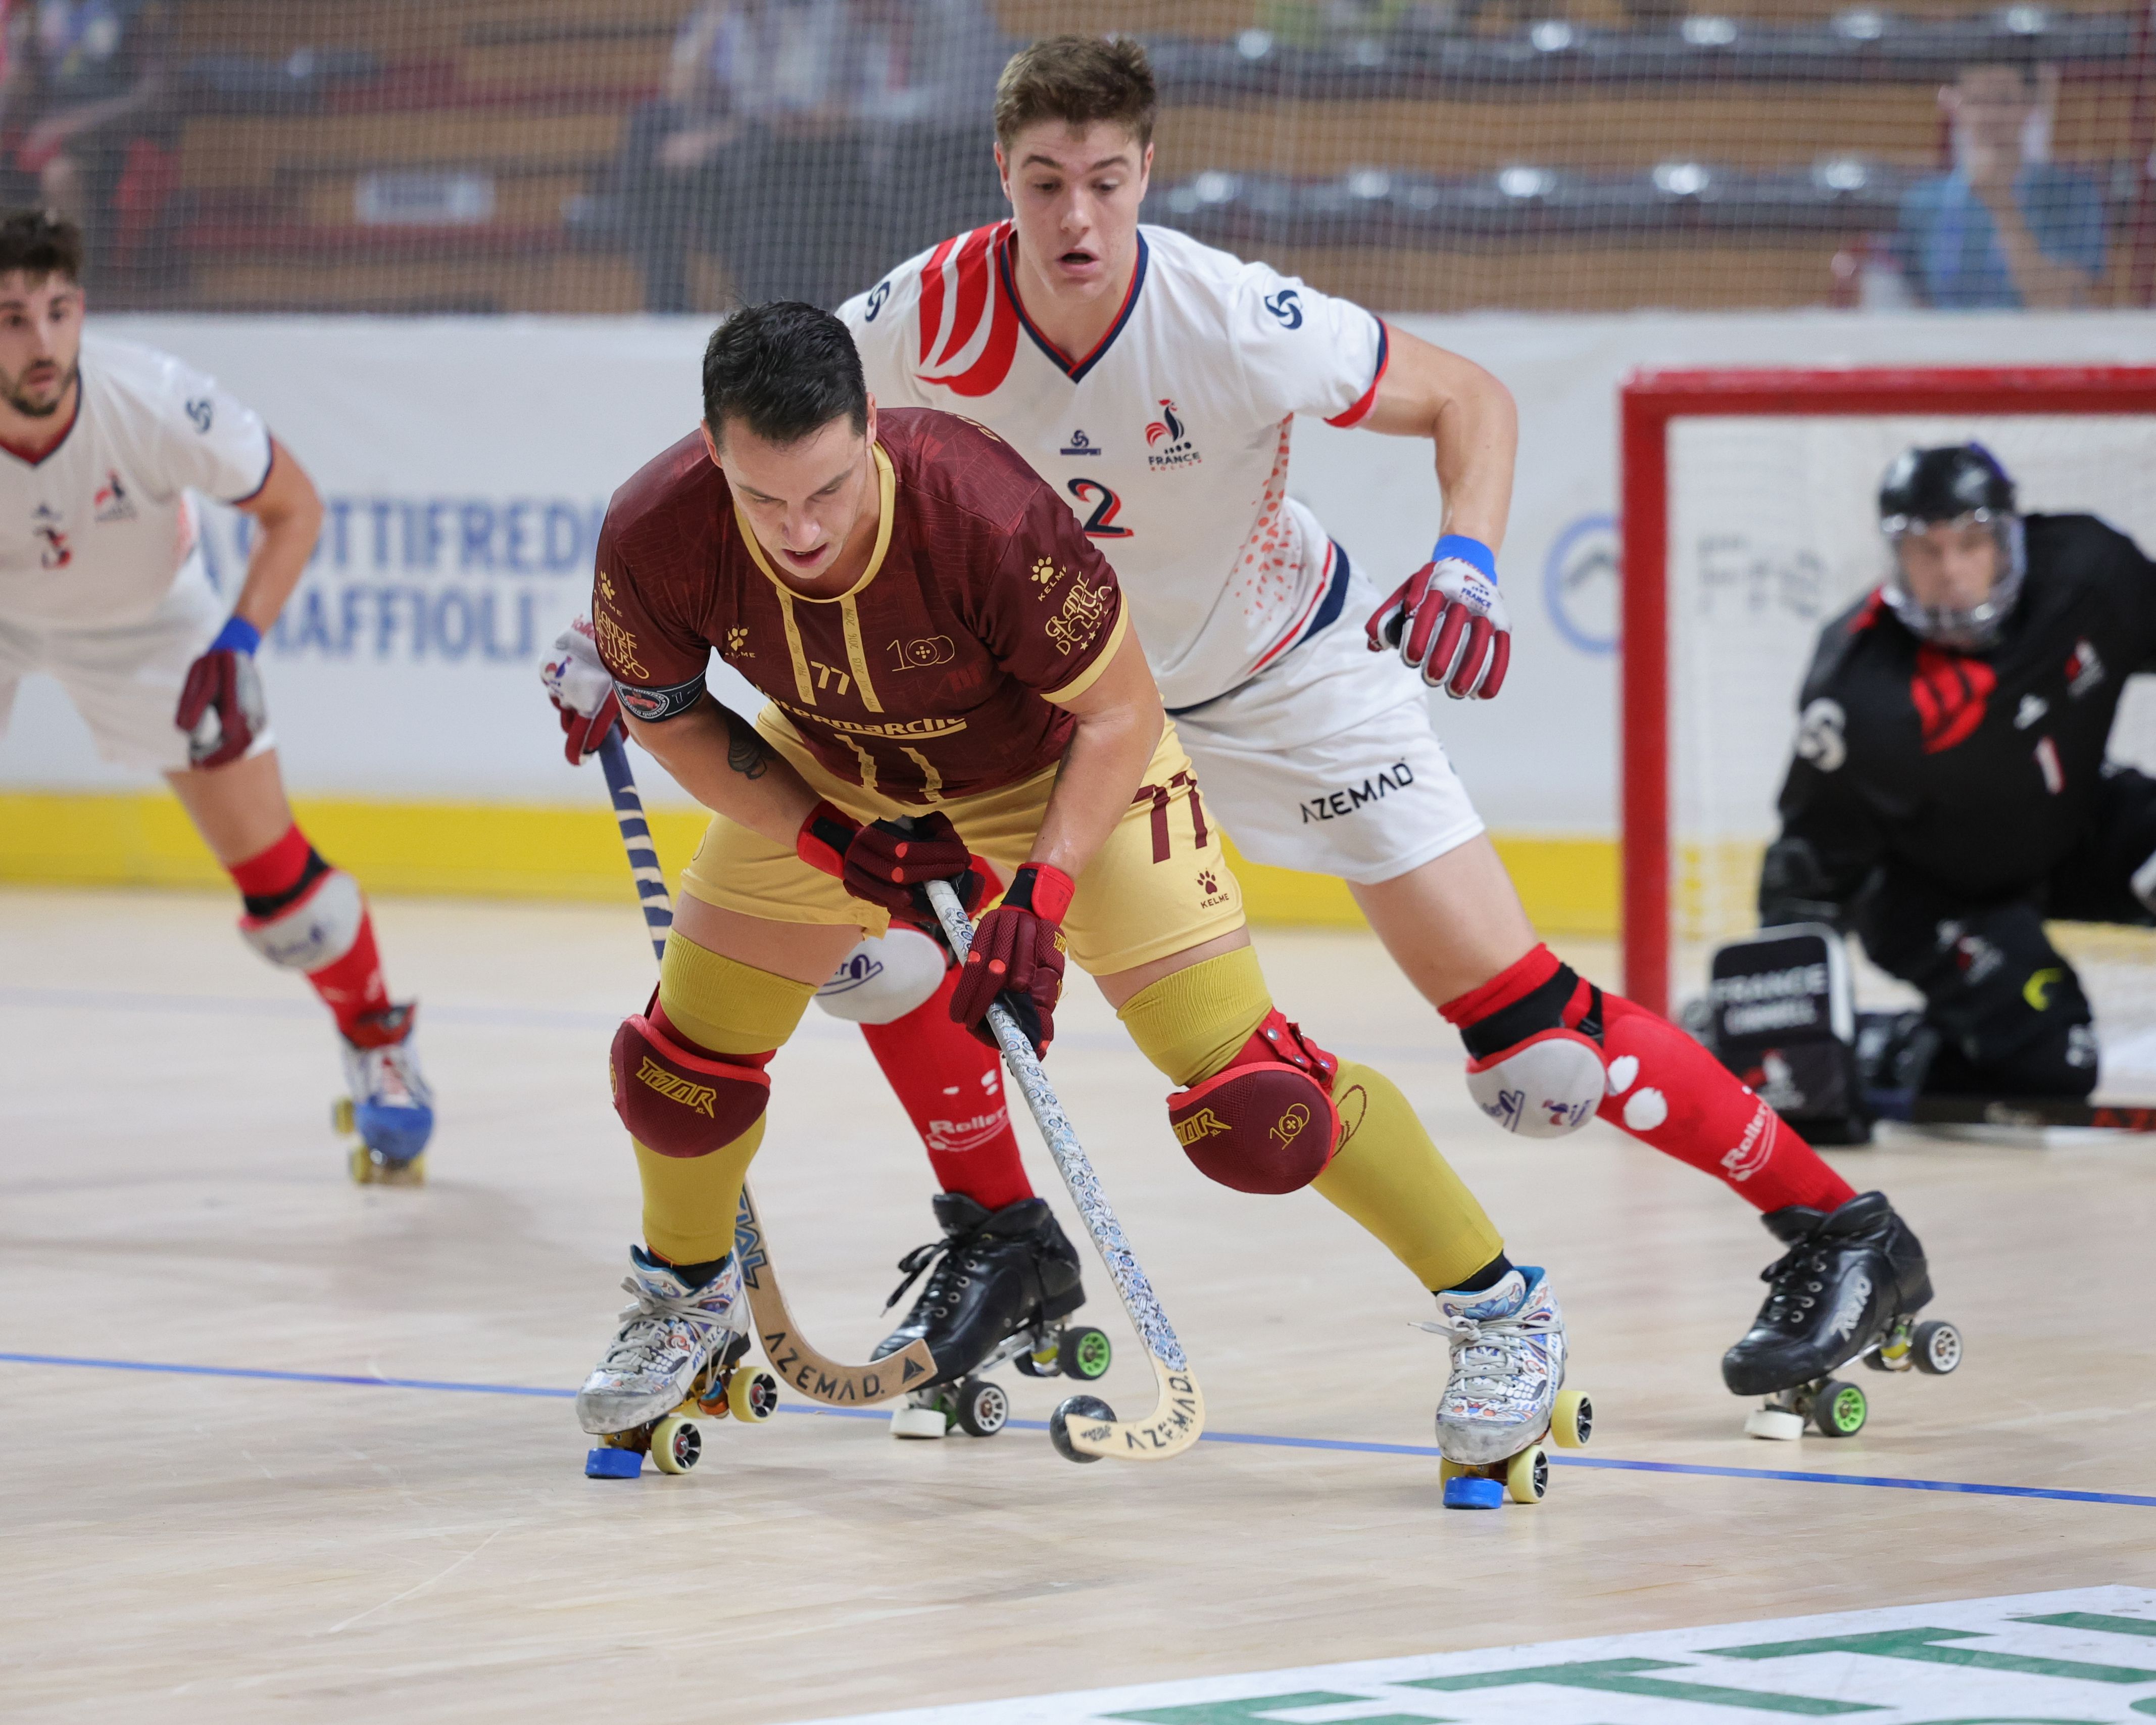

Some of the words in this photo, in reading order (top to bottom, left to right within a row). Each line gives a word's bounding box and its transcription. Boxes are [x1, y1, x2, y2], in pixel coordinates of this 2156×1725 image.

[1148, 451, 1201, 465] FRANCE
[810, 661, 850, 695] 77
[1131, 770, 1208, 865] 77
[1200, 893, 1230, 909] KELME
